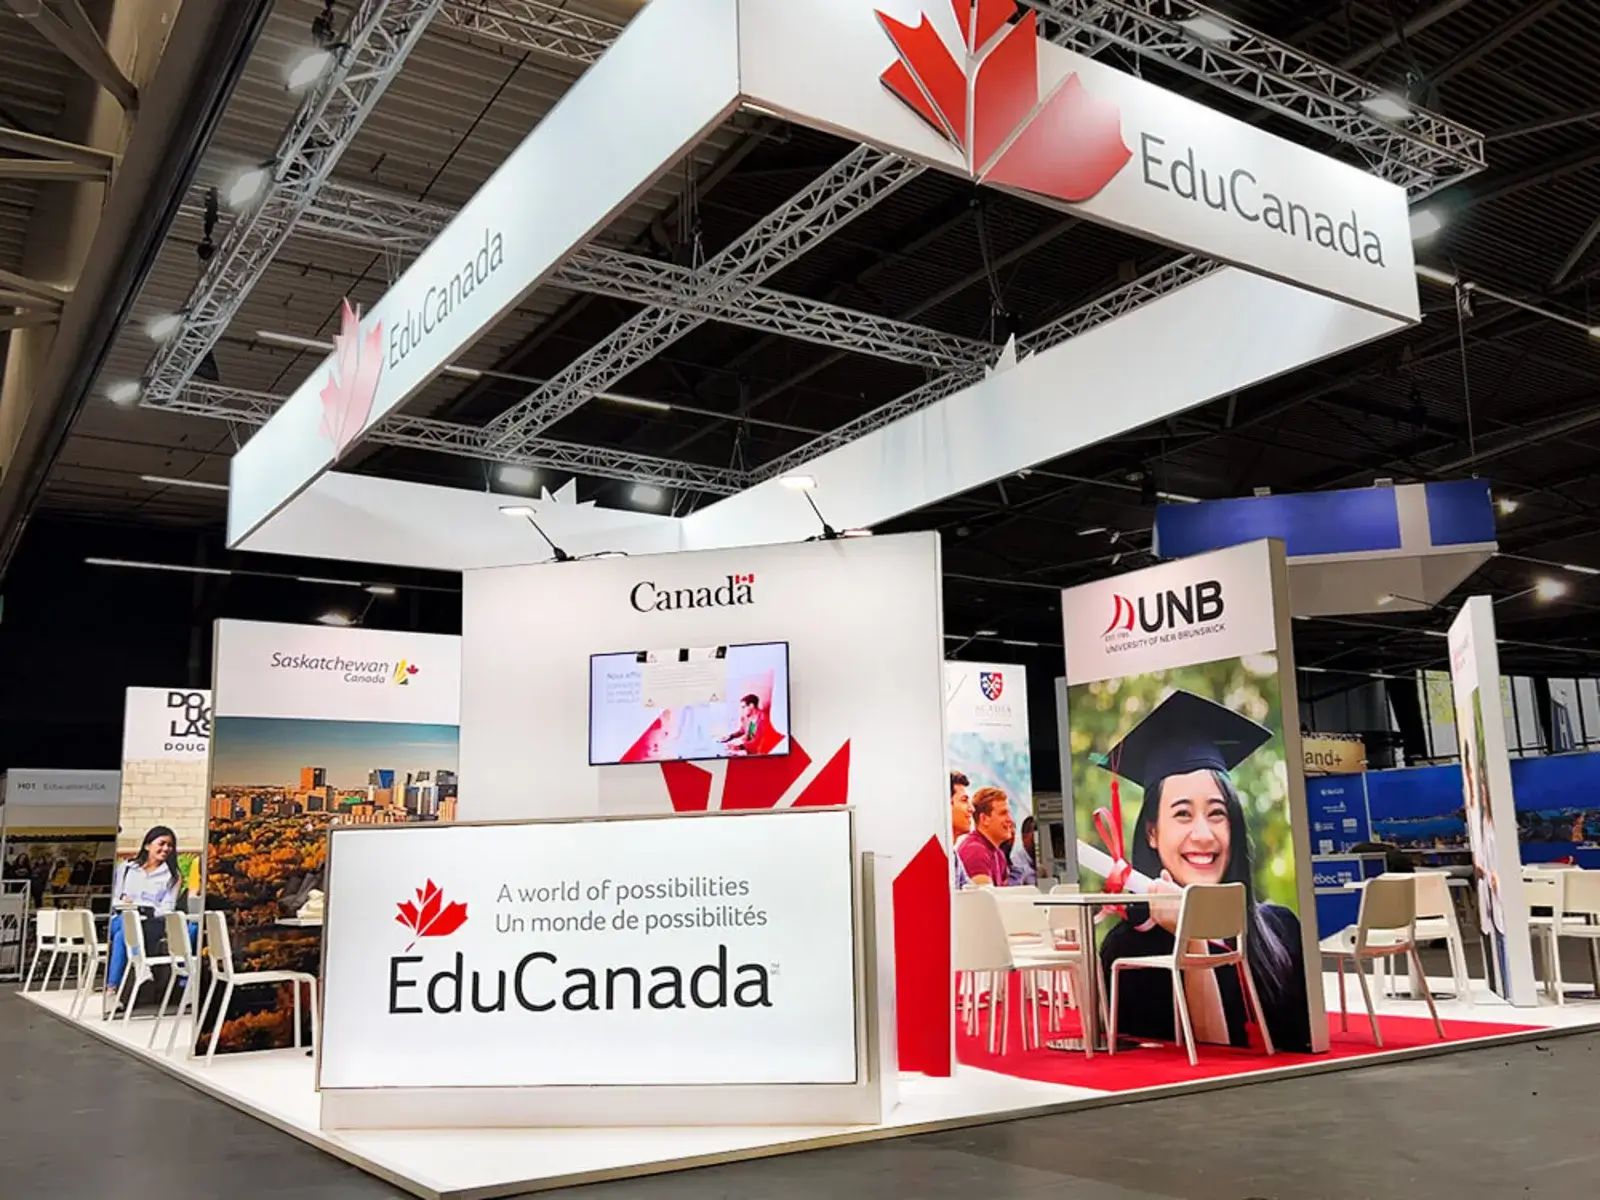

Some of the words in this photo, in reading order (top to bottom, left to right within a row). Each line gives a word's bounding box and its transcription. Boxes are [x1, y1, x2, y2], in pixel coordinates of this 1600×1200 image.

[1140, 131, 1386, 268] EduCanada
[389, 228, 504, 370] EduCanada
[630, 575, 754, 612] Canada
[1138, 580, 1225, 633] UNB
[1105, 639, 1148, 654] UNIVERSITY
[1148, 636, 1159, 647] OF
[1160, 633, 1177, 644] NEW
[1178, 624, 1226, 640] BRUNSWICK
[270, 652, 390, 673] Saskatchewan
[344, 673, 386, 684] Canada
[496, 883, 513, 903] A
[518, 880, 581, 903] world
[586, 877, 611, 901] of
[616, 876, 750, 905] possibilities
[495, 913, 525, 933] Un
[531, 909, 607, 932] monde
[612, 909, 640, 932] de
[645, 905, 768, 934] possibilités
[388, 944, 774, 1014] EduCanada
